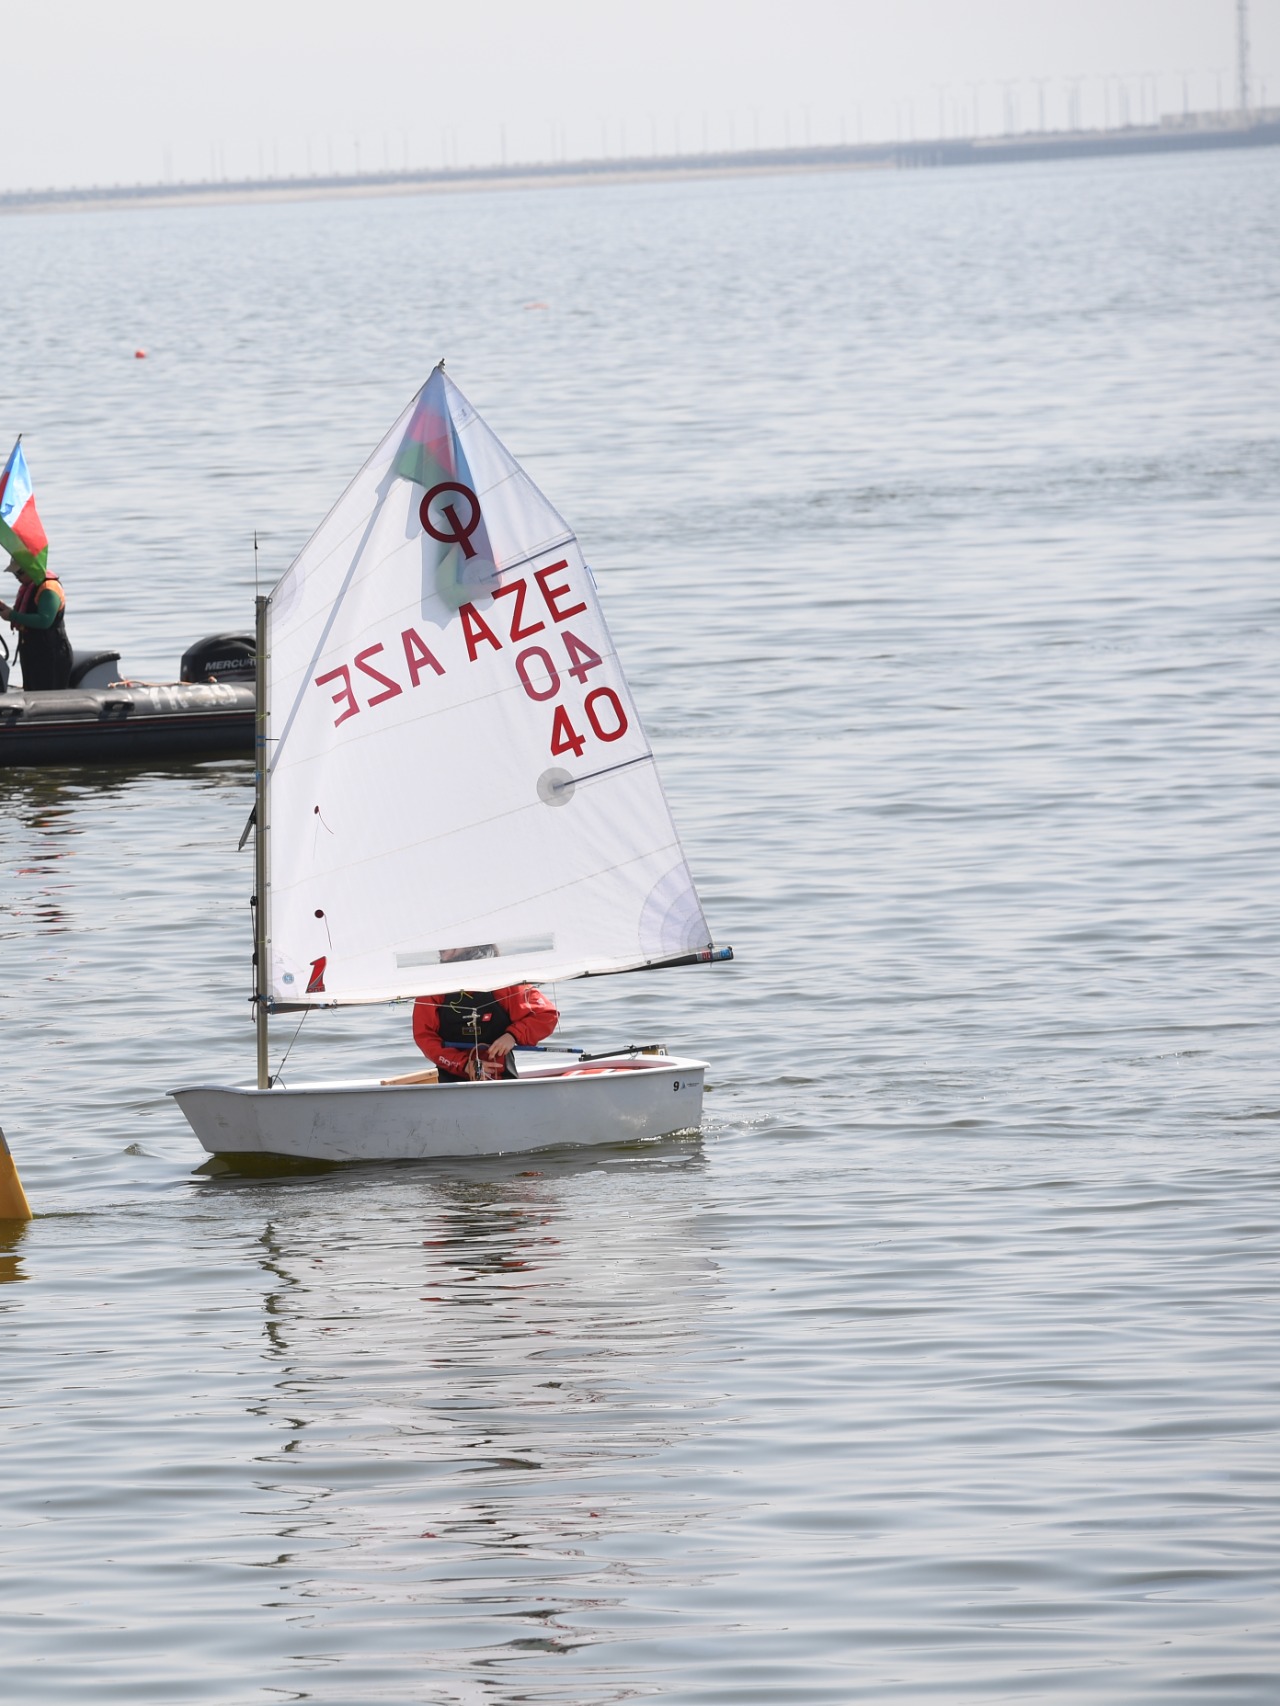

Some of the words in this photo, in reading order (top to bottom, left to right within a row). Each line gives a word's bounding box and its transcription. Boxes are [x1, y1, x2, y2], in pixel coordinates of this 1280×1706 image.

[458, 559, 587, 662] AZE
[205, 658, 257, 671] MERCUR
[550, 687, 628, 757] 40
[673, 1081, 680, 1092] 9
